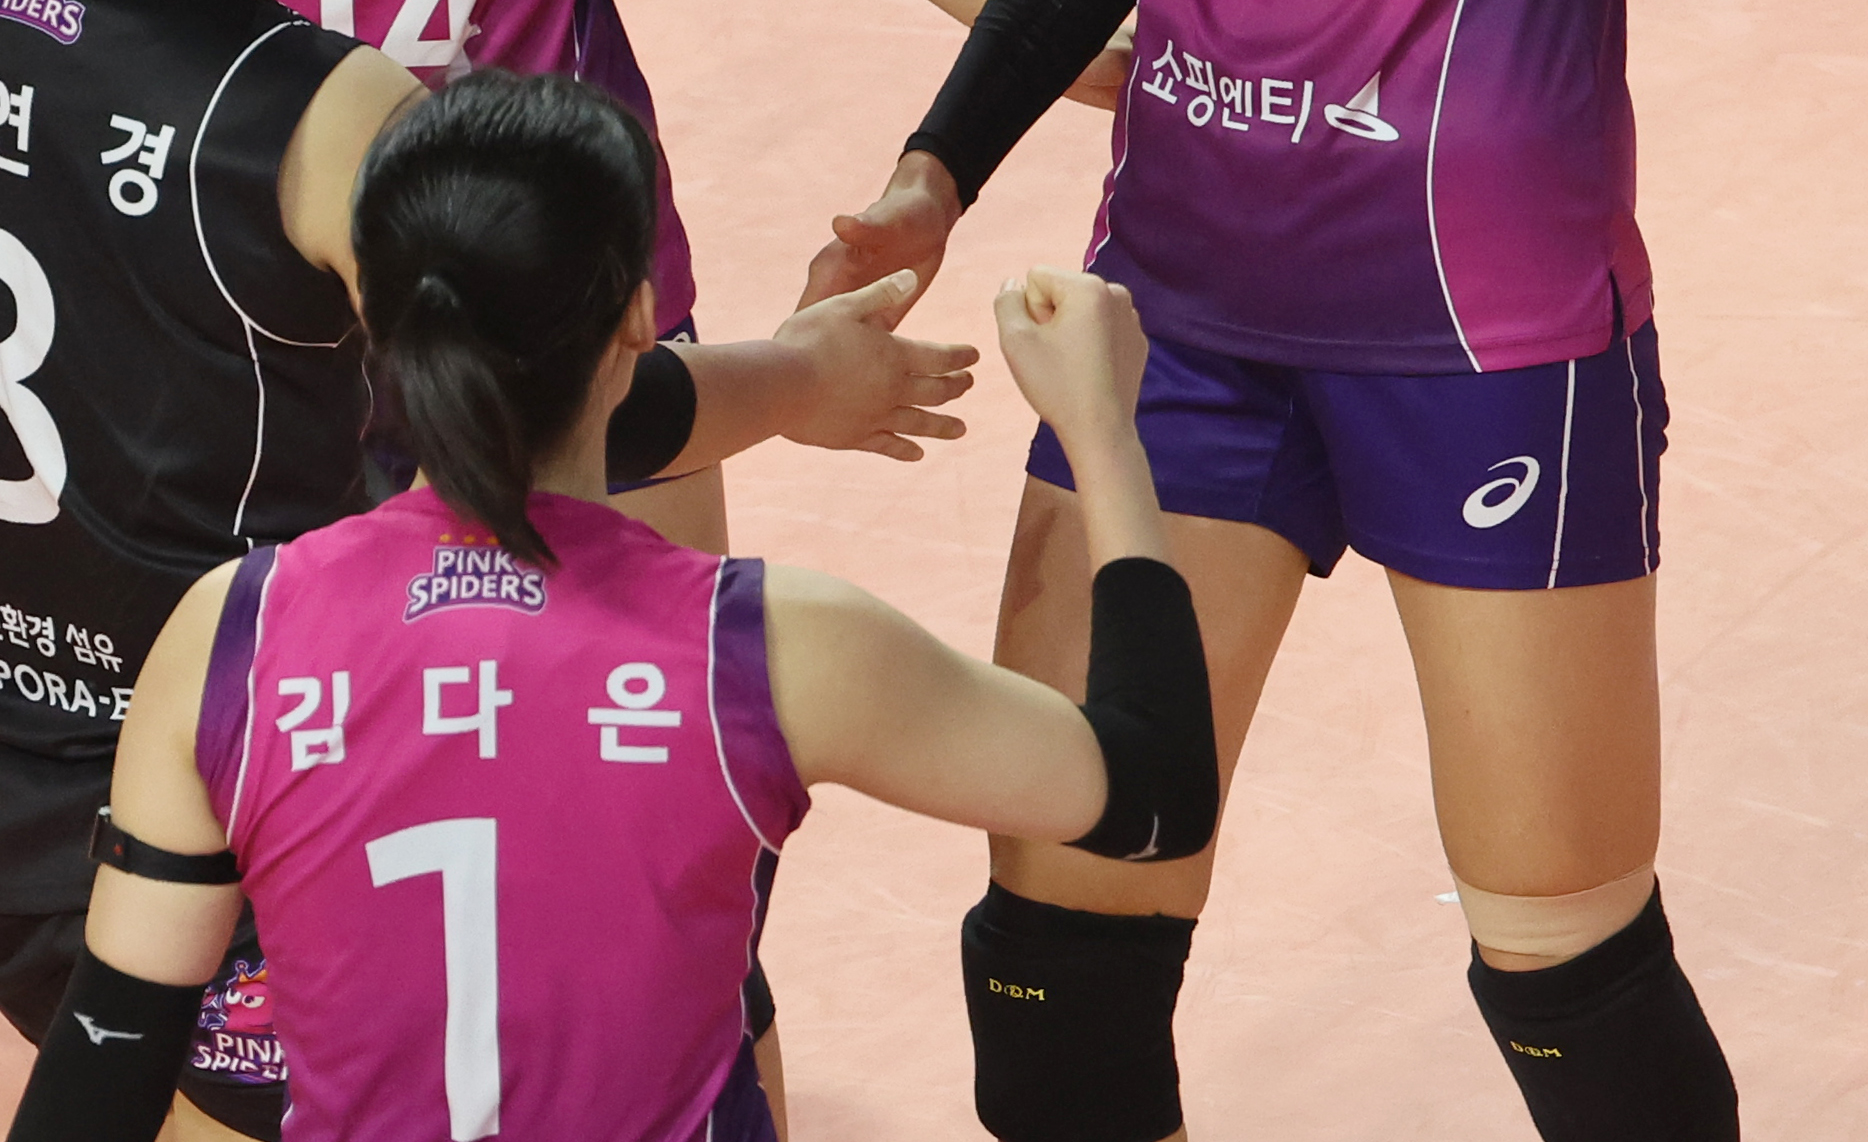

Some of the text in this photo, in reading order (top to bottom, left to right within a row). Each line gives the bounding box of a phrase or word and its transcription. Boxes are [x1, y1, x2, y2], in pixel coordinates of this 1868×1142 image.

[1141, 39, 1314, 144] 쇼핑엔티
[409, 574, 543, 614] SPIDERS
[437, 549, 514, 575] PINK
[0, 604, 123, 673] 환경 섬유
[365, 817, 500, 1142] 1
